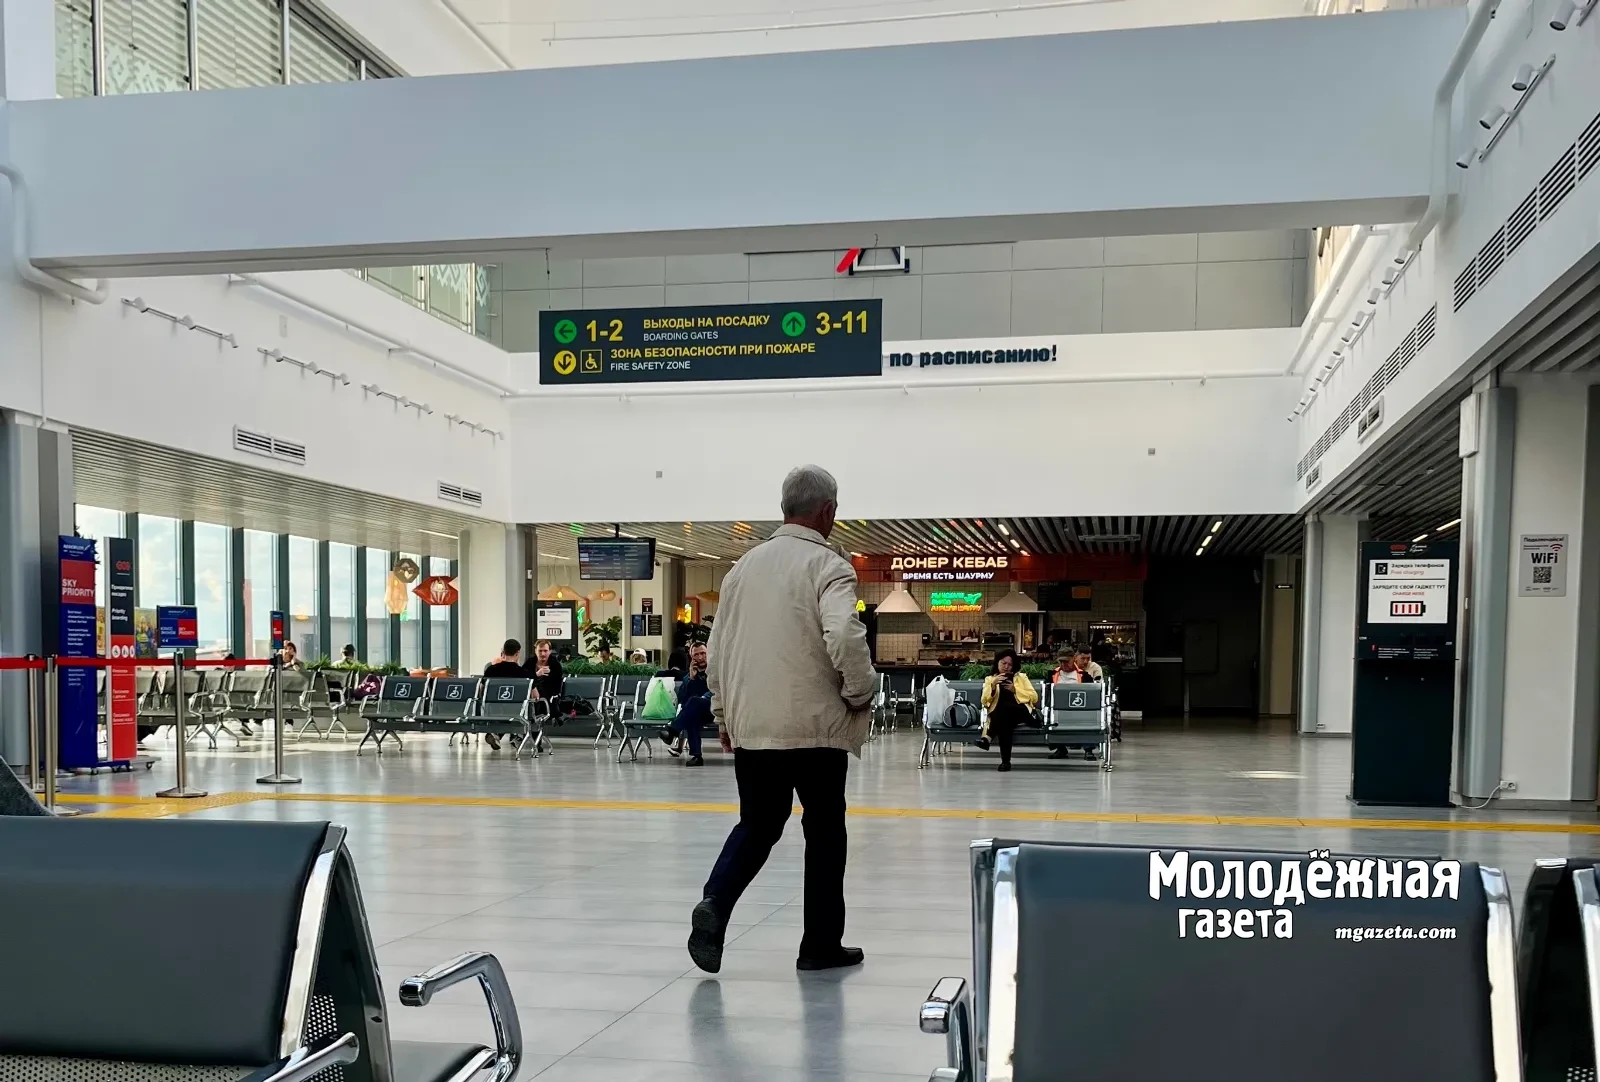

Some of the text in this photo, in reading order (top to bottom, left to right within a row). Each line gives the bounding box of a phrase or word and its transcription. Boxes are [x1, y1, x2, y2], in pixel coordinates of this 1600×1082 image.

[643, 314, 771, 330] ВЫХОДЫ НА ПОСАДКУ
[815, 310, 868, 335] 3-11
[586, 319, 624, 342] 1-2
[643, 331, 719, 342] BOARDING GATES
[610, 342, 816, 359] ЗОНА БЕЗОПАСНОСТИ ПРИ ПОЖАРЕ
[889, 344, 1057, 368] по расписанию!
[610, 360, 691, 371] FIRE SAFETY ZONE
[891, 556, 1008, 570] ДОНЕР КЕБАБ
[1531, 552, 1558, 564] WiFi
[902, 572, 995, 580] ВРЕМЯ ЕСТЬ ШАУРМУ
[62, 579, 77, 588] SKY
[61, 587, 95, 597] PRIORITY
